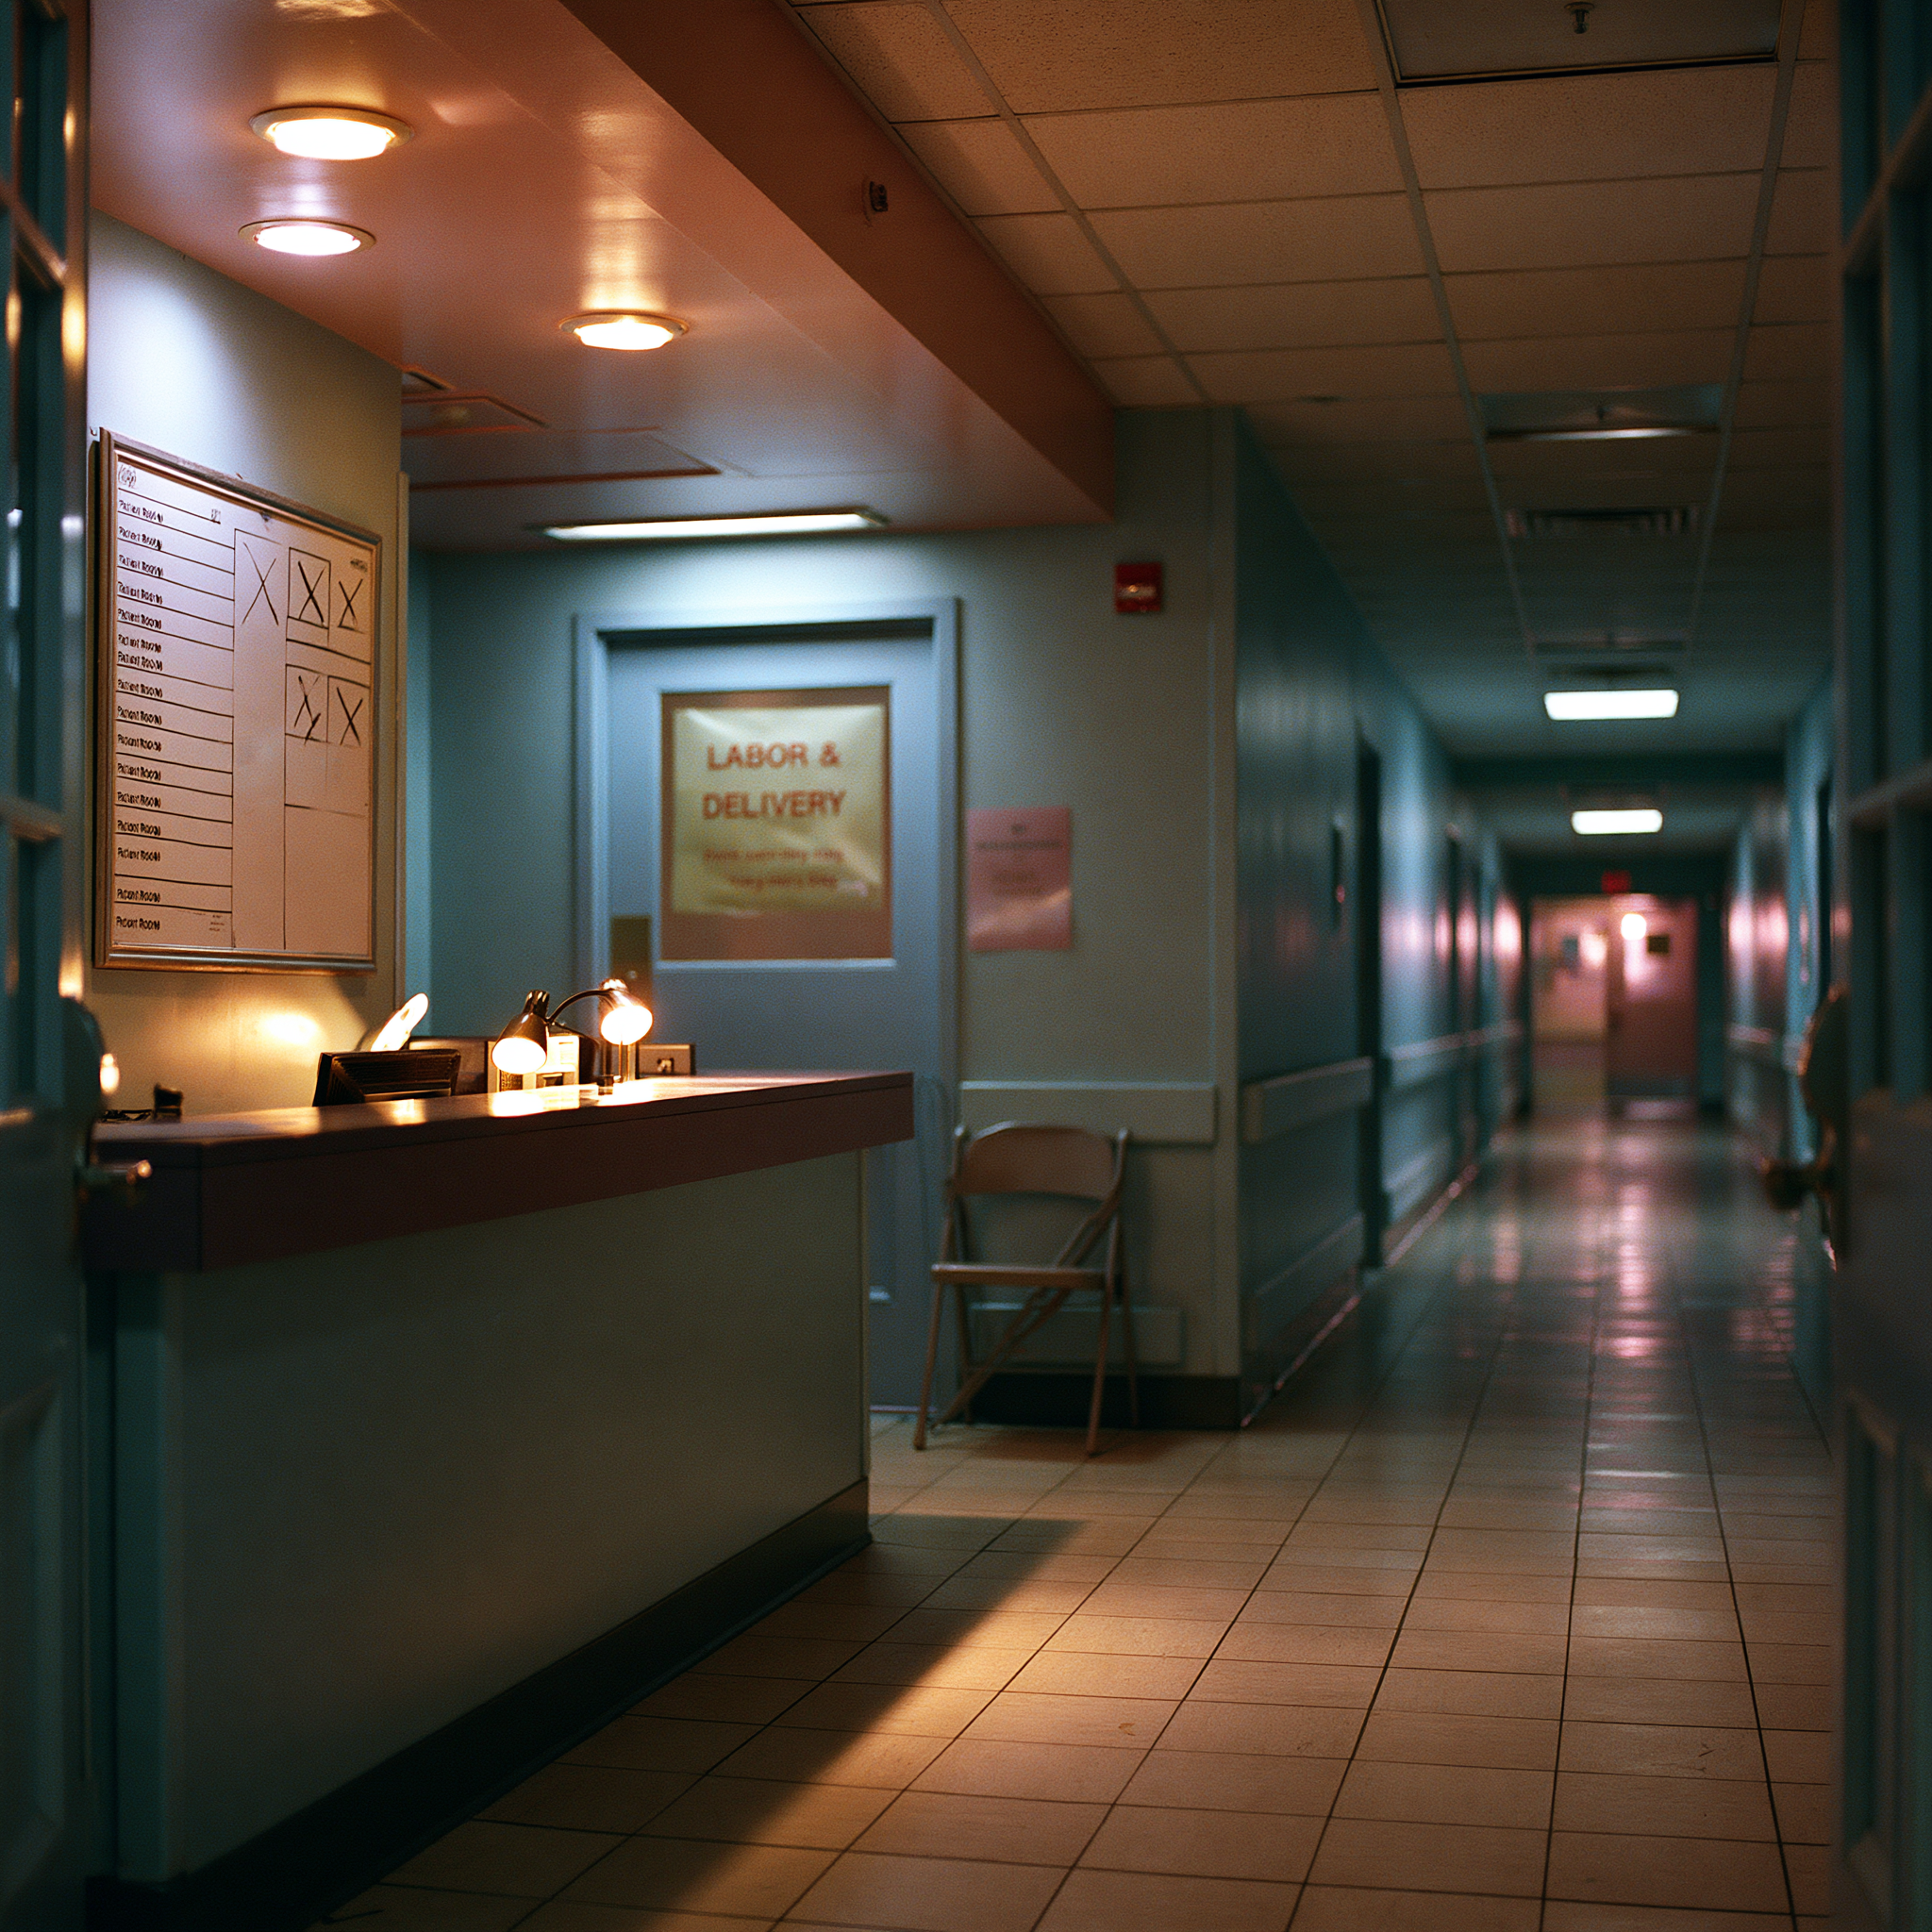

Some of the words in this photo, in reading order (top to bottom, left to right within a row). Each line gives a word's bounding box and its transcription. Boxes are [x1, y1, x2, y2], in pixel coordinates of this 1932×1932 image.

[708, 741, 809, 771] LABOR
[819, 741, 841, 768] &
[702, 790, 847, 820] DELIVERY
